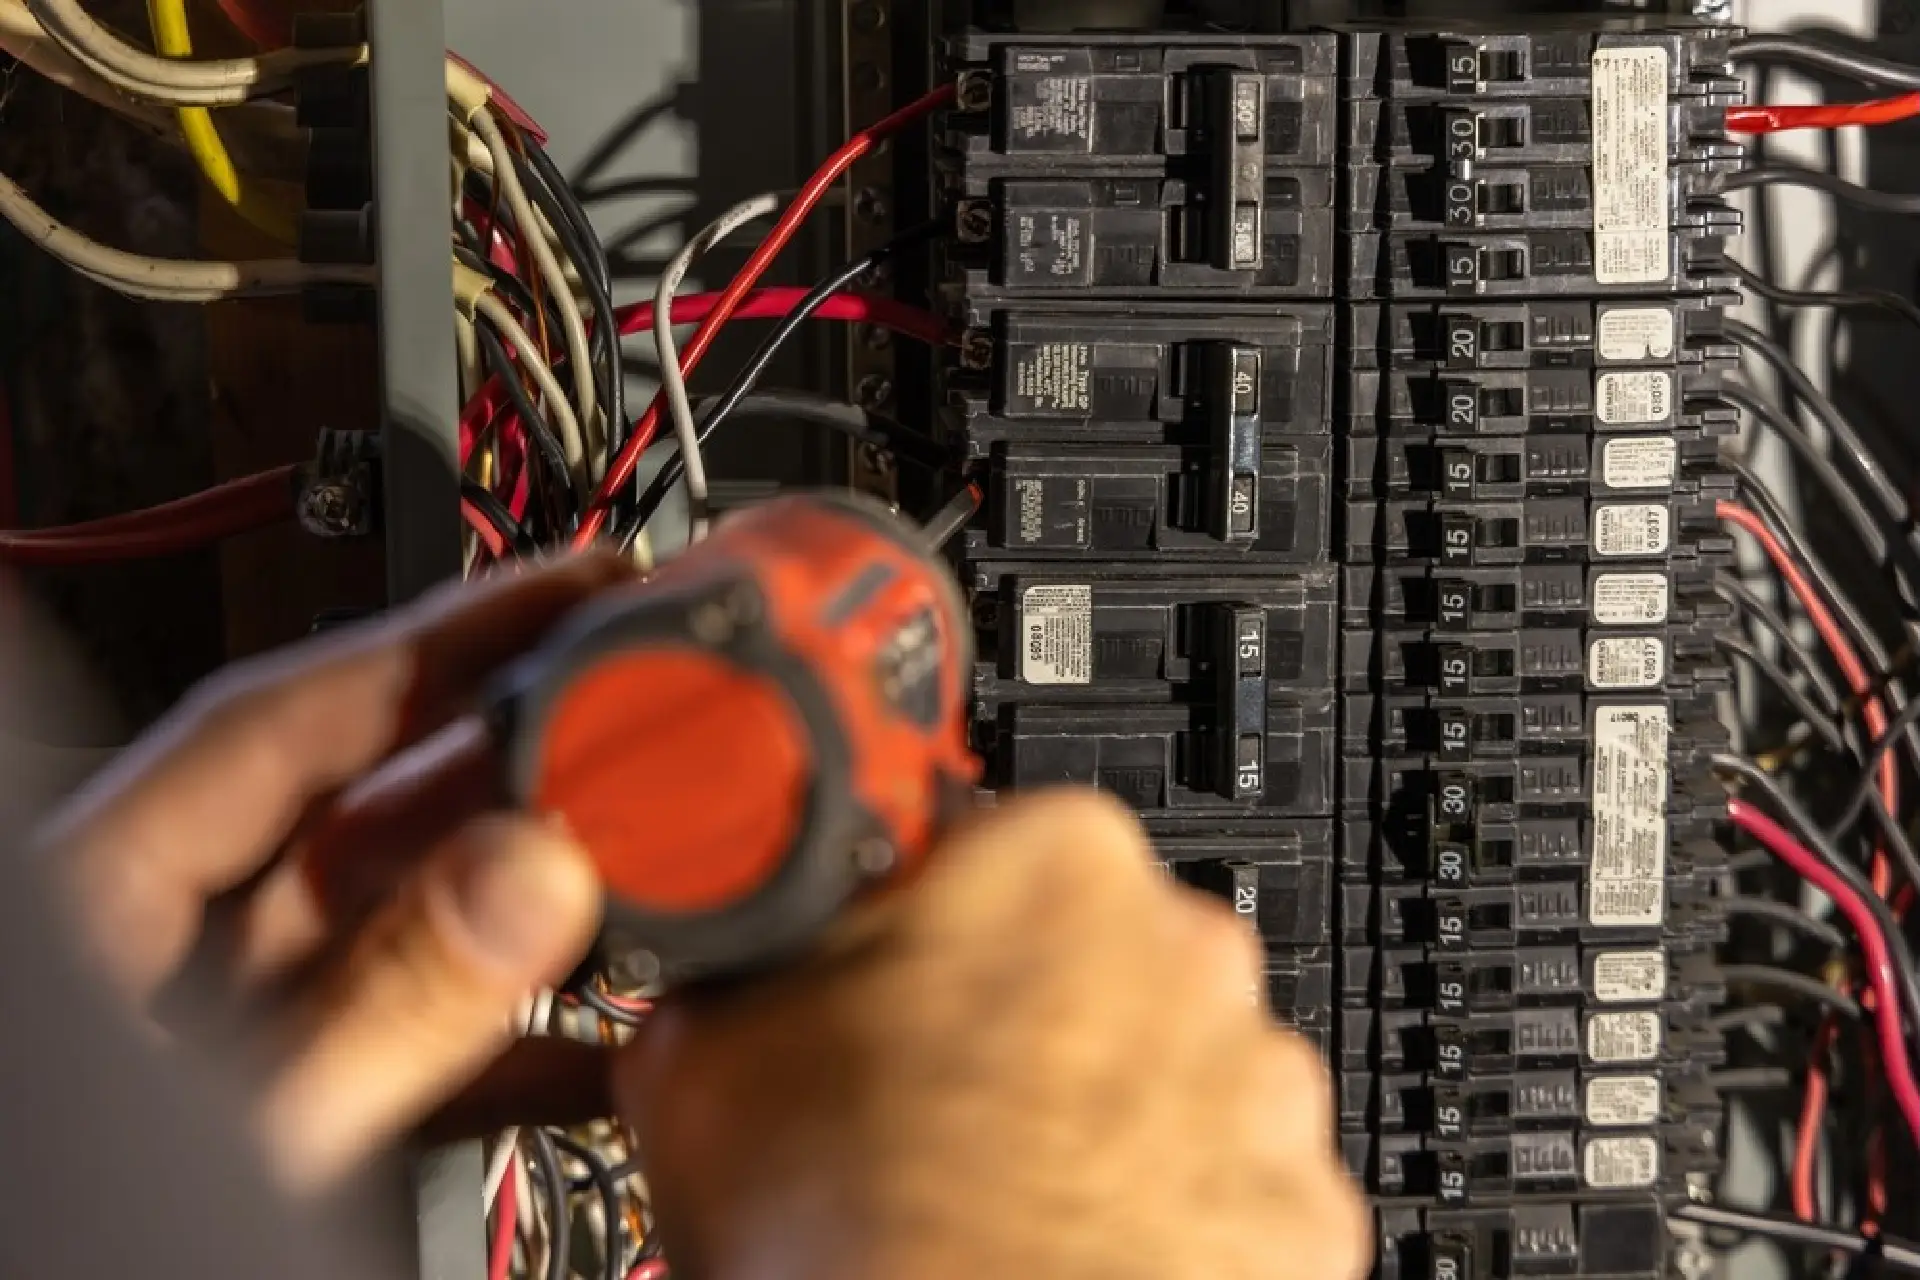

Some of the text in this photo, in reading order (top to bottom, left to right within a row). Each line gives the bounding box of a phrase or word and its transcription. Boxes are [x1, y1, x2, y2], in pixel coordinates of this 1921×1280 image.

[1452, 56, 1475, 85] 15
[1451, 119, 1474, 156] 30
[1450, 184, 1472, 224] 30
[1451, 257, 1474, 287] 15
[1452, 329, 1474, 358] 20
[1235, 371, 1253, 394] 40
[1452, 395, 1474, 424] 20
[1448, 463, 1471, 492] 15
[1232, 490, 1249, 514] 40
[1446, 529, 1469, 558] 15
[1442, 594, 1464, 622] 15
[1239, 630, 1259, 658] 15
[1443, 659, 1466, 688] 15
[1443, 722, 1466, 751] 15
[1239, 760, 1259, 788] 15
[1442, 785, 1465, 814] 30
[1439, 851, 1462, 880] 30
[1236, 886, 1257, 913] 20
[1440, 916, 1463, 946] 15
[1440, 982, 1463, 1010] 15
[1439, 1044, 1462, 1073] 15
[1438, 1106, 1461, 1136] 15
[1441, 1171, 1464, 1200] 15
